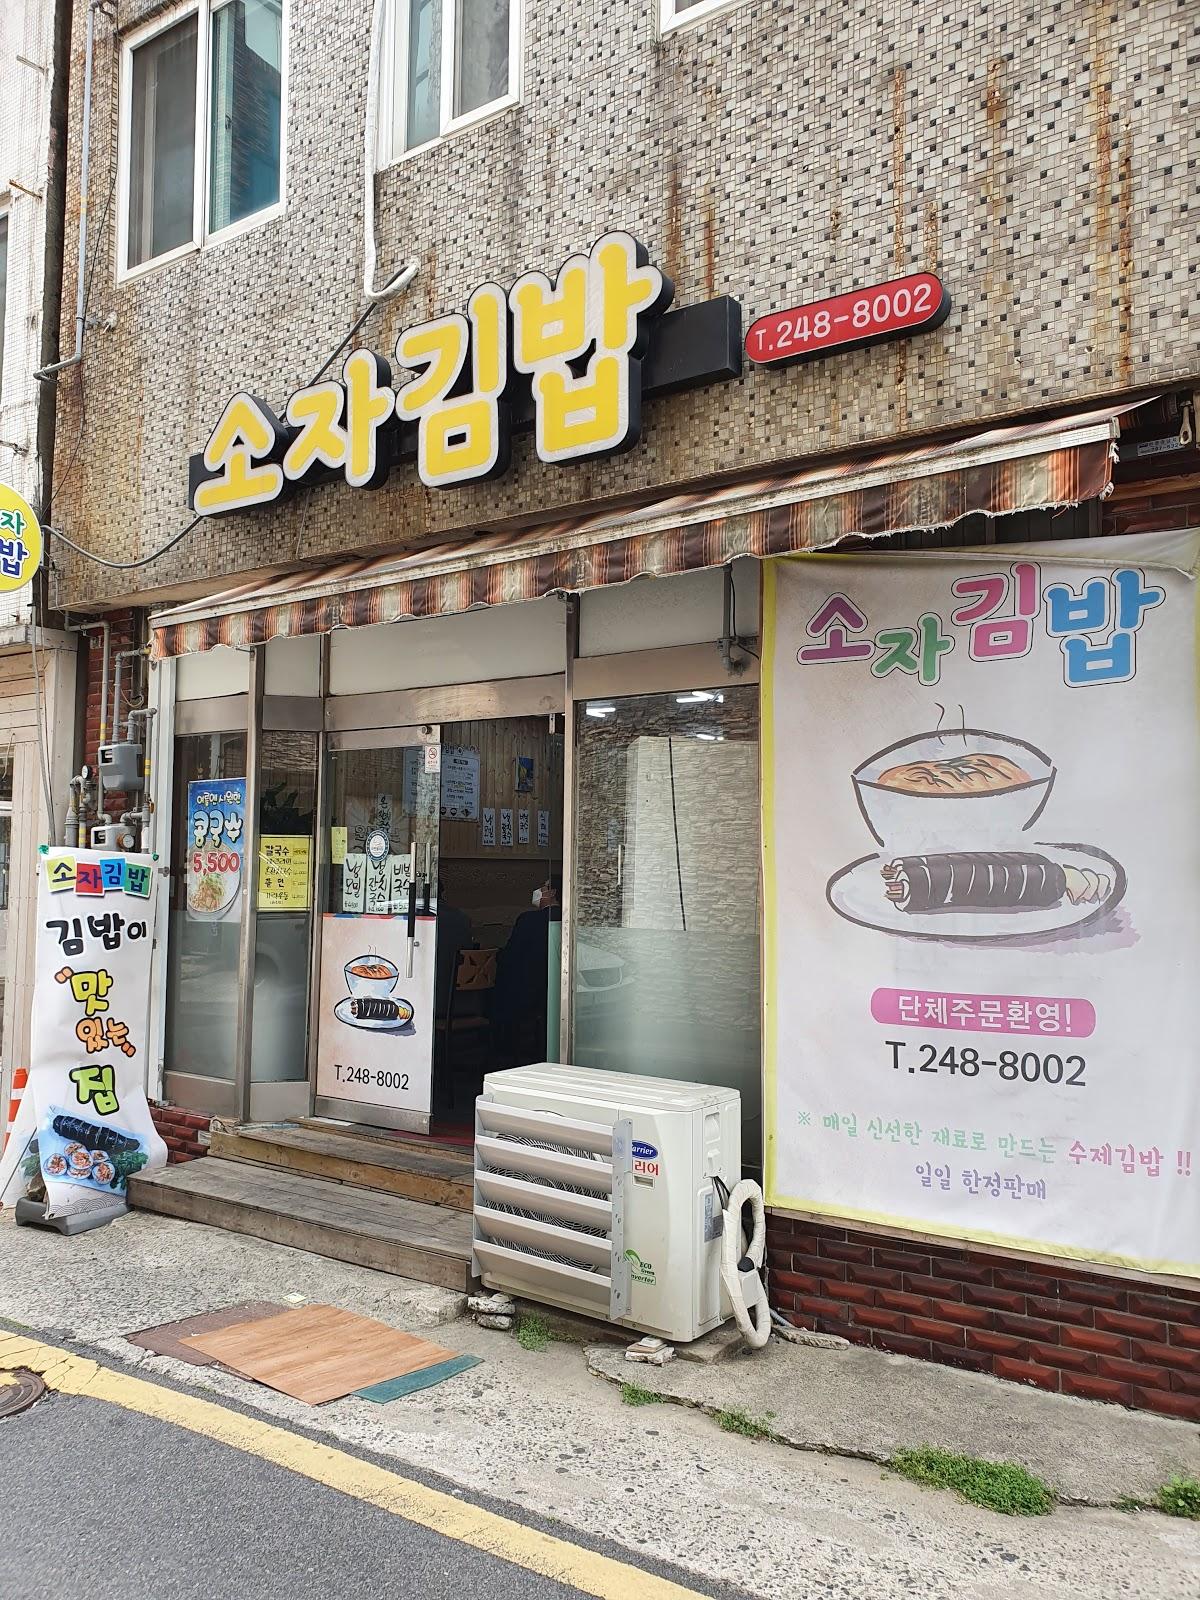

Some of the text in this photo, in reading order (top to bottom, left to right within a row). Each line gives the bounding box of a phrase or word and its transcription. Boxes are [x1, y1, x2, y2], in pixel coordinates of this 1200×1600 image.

[754, 282, 932, 352] T.248-8002
[193, 231, 662, 518] 소자김밥
[0, 510, 26, 536] 자
[797, 561, 1166, 688] 소자김밥
[193, 808, 244, 849] 콩국수
[52, 861, 149, 893] 소자김밥
[193, 852, 240, 876] 5,500
[46, 913, 147, 956] 김밥이
[70, 968, 113, 1016] 맛
[897, 994, 1073, 1033] 단체주문환영!
[76, 1016, 130, 1054] 있는
[334, 1064, 410, 1091] T.248-8002
[884, 1040, 1088, 1088] T.248-8002
[68, 1064, 119, 1116] 집
[632, 1146, 654, 1155] arrier
[822, 1112, 858, 1138] 매일
[866, 1116, 923, 1147] 신선한
[931, 1127, 987, 1152] 재료로
[998, 1132, 1057, 1164] 만드는
[1068, 1139, 1164, 1177] 수제김밥
[631, 1160, 659, 1176] 리어
[915, 1160, 1047, 1200] 일일 한정판매
[631, 1273, 654, 1283] nverter
